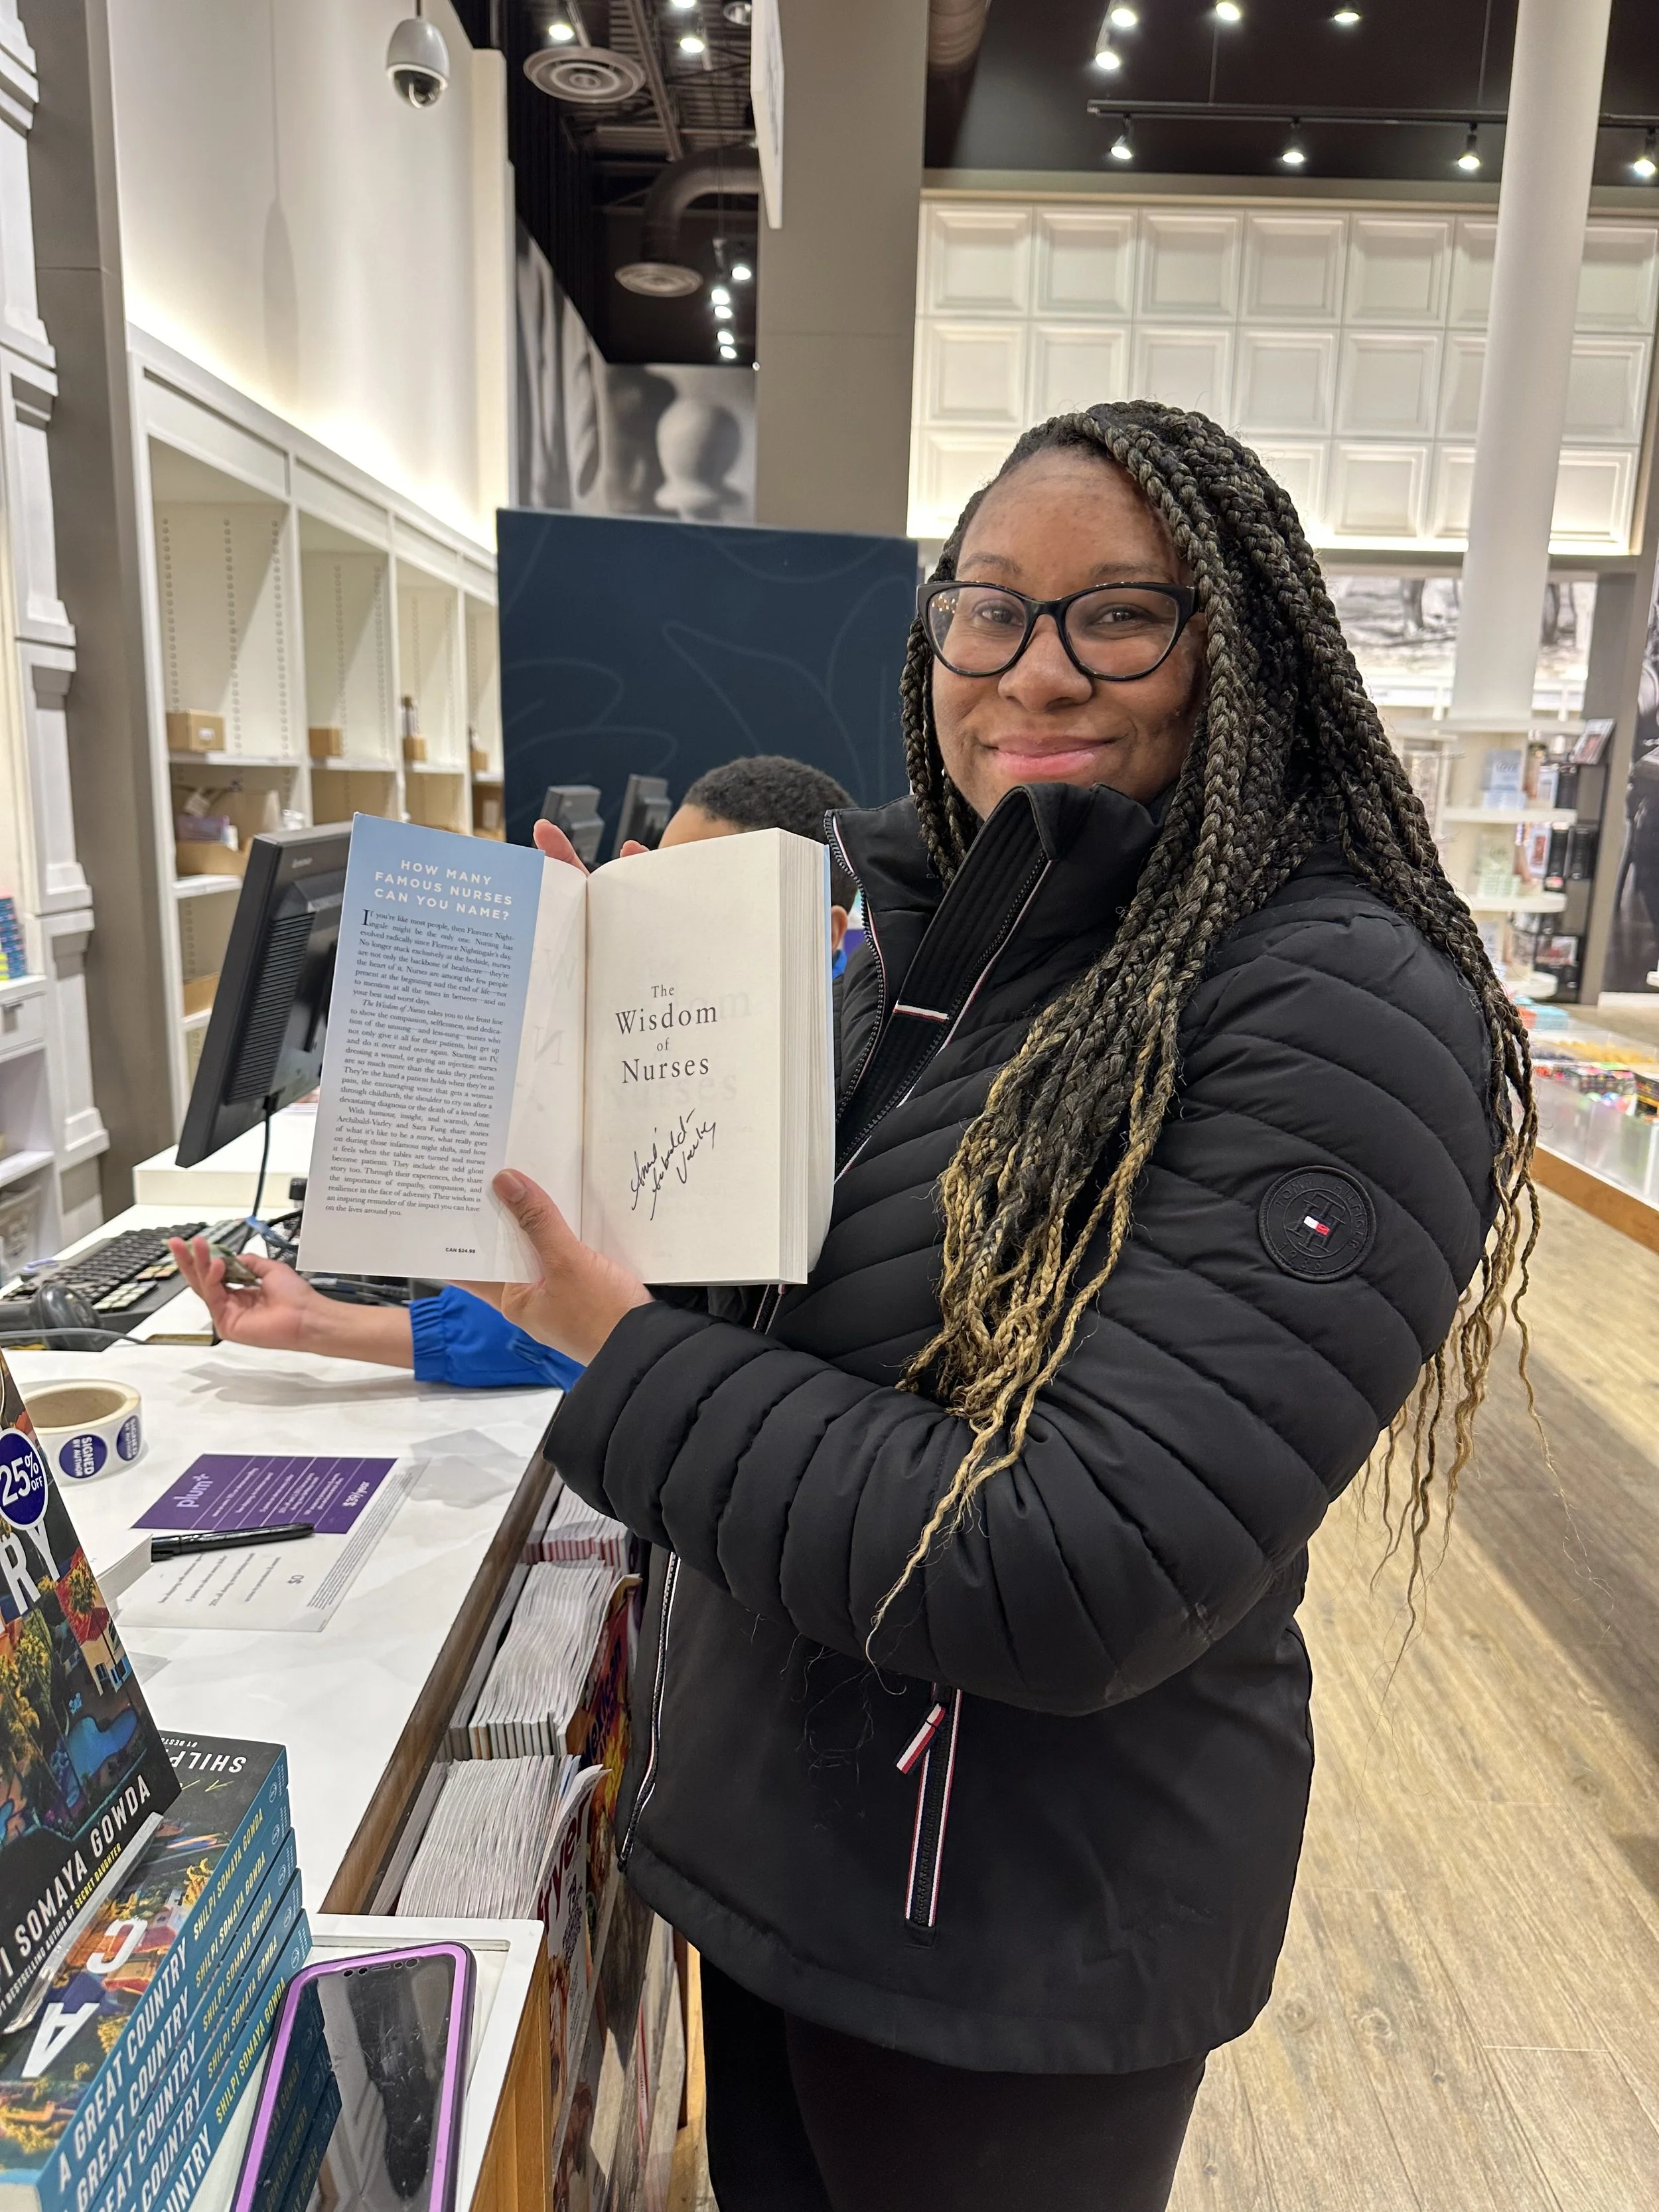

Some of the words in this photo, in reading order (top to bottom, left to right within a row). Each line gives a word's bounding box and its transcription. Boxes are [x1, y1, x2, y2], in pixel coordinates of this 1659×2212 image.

[401, 860, 439, 876] HOW
[447, 869, 492, 885] MANY
[374, 872, 442, 893] FAMOUS
[450, 887, 512, 905] NURSES
[374, 888, 407, 903] CAN
[417, 895, 449, 911] YOU
[456, 903, 510, 921] NAME?
[362, 909, 374, 926] If
[376, 911, 396, 923] you're
[397, 915, 408, 923] like
[410, 917, 426, 926] most
[451, 924, 465, 932] then
[467, 926, 493, 937] Florence
[359, 938, 370, 947] No
[371, 940, 392, 952] longer
[394, 944, 410, 953] stuck
[411, 947, 445, 960] exclusively
[353, 989, 368, 998] your
[369, 990, 382, 998] best
[383, 992, 396, 1000] and
[397, 994, 415, 1003] worst
[651, 985, 675, 998] The
[375, 1001, 399, 1010] Wisdom
[407, 1005, 426, 1014] Nurses
[427, 1008, 443, 1017] takes
[476, 1015, 491, 1023] front
[615, 1002, 717, 1035] Wisdom
[361, 1029, 376, 1039] only
[378, 1031, 392, 1041] give
[480, 1044, 489, 1053] get
[656, 1037, 670, 1051] of
[343, 1066, 370, 1078] They're
[383, 1070, 400, 1079] hand
[406, 1074, 429, 1084] patient
[467, 1080, 487, 1091] they're
[622, 1057, 709, 1084] Nurses
[340, 1086, 367, 1097] through
[415, 1094, 442, 1103] shoulder
[337, 1115, 392, 1129] Archibald-Varley
[430, 1125, 447, 1134] Fung
[330, 1164, 346, 1174] story
[364, 1167, 394, 1178] Through
[451, 1175, 465, 1184] they
[1273, 1176, 1326, 1208] TOMMY
[1333, 1182, 1365, 1250] HILFIGER
[72, 1438, 81, 1447] BY
[82, 1436, 95, 1476] SIGNED
[74, 1448, 84, 1477] AUTHOR
[0, 1451, 39, 1507] 25%
[31, 1475, 44, 1492] OFF
[342, 1481, 370, 1508] $39/year
[287, 1574, 305, 1585] $0
[15, 1850, 88, 1957] SOMAYA
[90, 1774, 151, 1858] GOWDA
[5, 1946, 46, 2004] BESTSELLING
[45, 1915, 68, 1951] AUTHOR
[66, 1905, 76, 1921] OF
[74, 1878, 96, 1910] SECRET
[94, 1842, 122, 1882] DAUGHTER
[60, 2152, 72, 2193] A
[74, 2049, 124, 2162] GREAT
[126, 1937, 187, 2065] COUNTRY
[193, 1890, 217, 1941] SHILPI
[216, 1846, 243, 1898] SOMAYA
[242, 1807, 264, 1852] GOWDA
[76, 2104, 125, 2212] GREAT
[128, 1986, 189, 2118] COUNTRY
[195, 1937, 219, 1988] SHILPI
[219, 1890, 245, 1945] SOMAYA
[244, 1851, 266, 1895] GOWDA
[135, 2029, 196, 2164] COUNTRY
[202, 1982, 226, 2033] SHILPI
[226, 1933, 252, 1987] SOMAYA
[251, 1891, 273, 1939] GOWDA
[215, 2071, 240, 2124] SHILPI
[238, 2019, 265, 2077] SOMAYA
[264, 1976, 287, 2024] GOWDA
[141, 2078, 200, 2212] COUNTRY
[207, 2027, 231, 2079] SHILPI
[230, 1977, 257, 2033] SOMAYA
[257, 1935, 278, 1982] GOWDA
